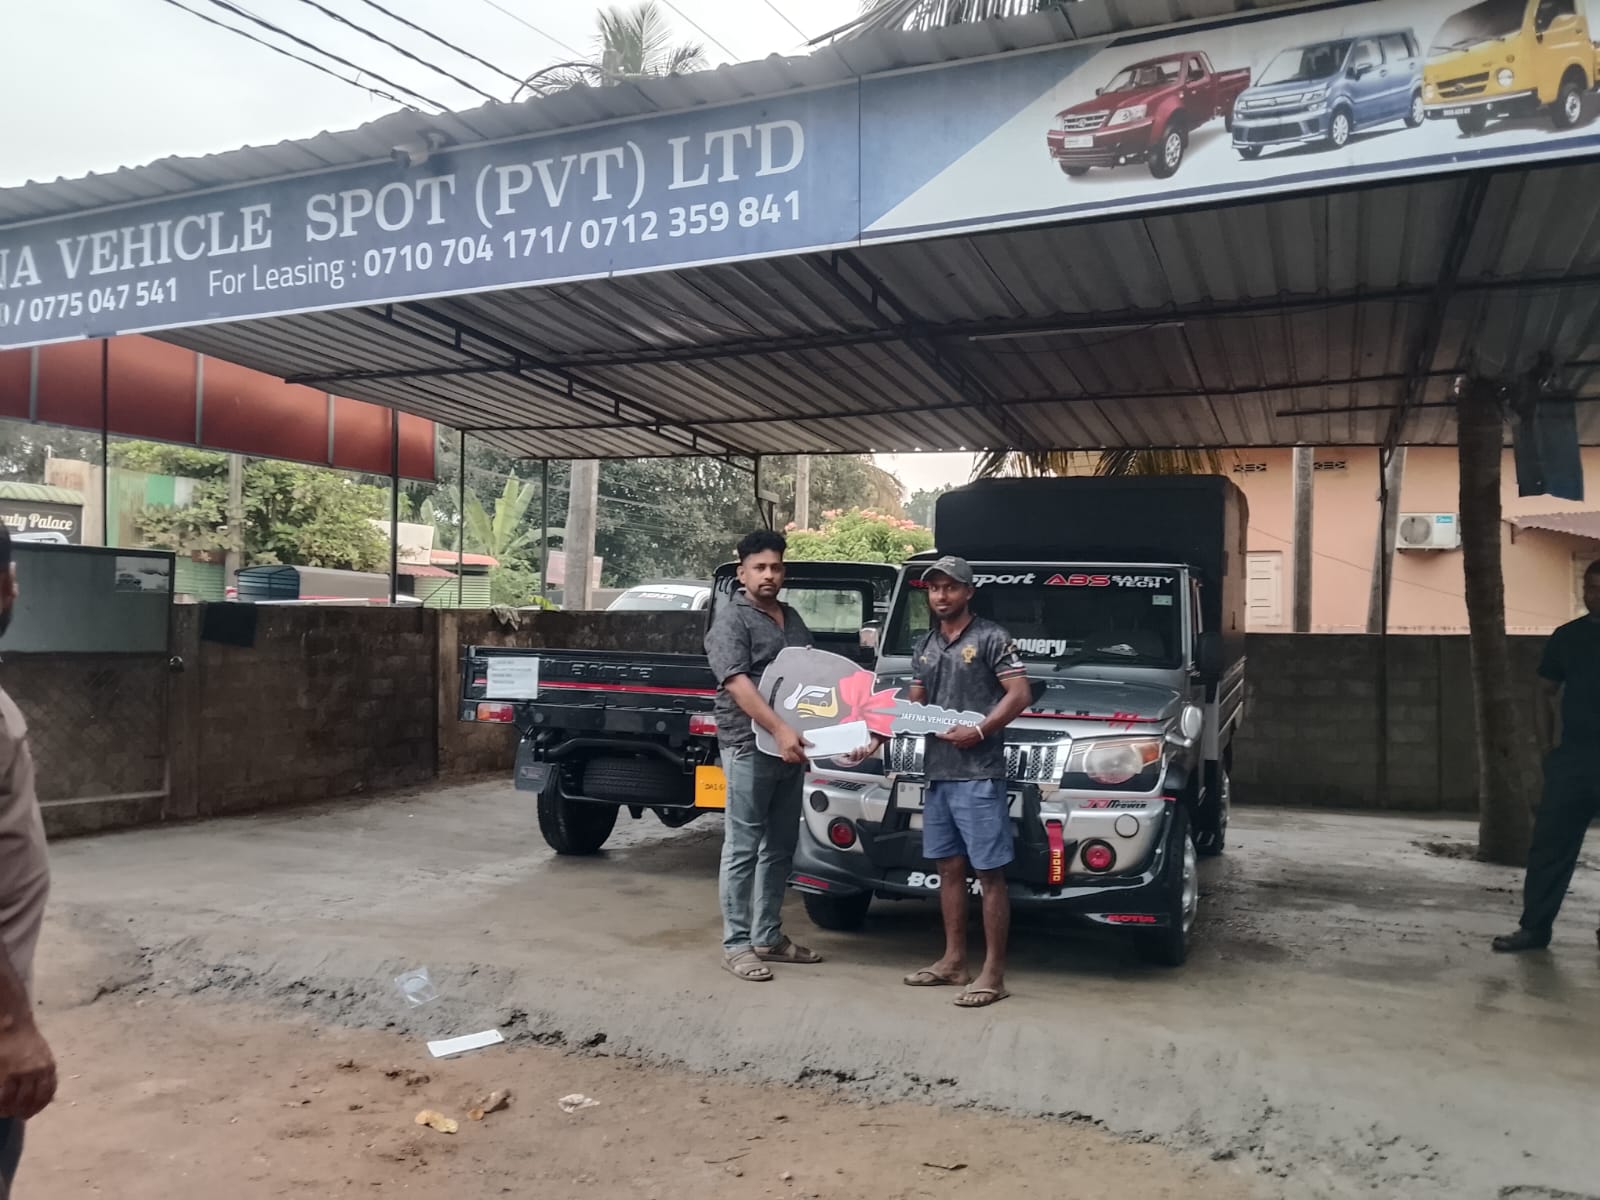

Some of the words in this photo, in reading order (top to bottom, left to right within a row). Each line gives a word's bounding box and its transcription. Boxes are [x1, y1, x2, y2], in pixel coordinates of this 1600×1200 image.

[57, 203, 273, 279] VEHICLE
[306, 174, 456, 242] SPOT
[475, 140, 645, 229] (PVT)
[668, 119, 804, 190] LTD
[30, 291, 83, 322] 0775
[88, 285, 130, 314] 047
[136, 277, 177, 307] 541
[209, 269, 246, 297] For
[253, 256, 344, 292] Leasing
[364, 242, 433, 277] 0710
[441, 234, 493, 267] 704
[580, 211, 658, 248] 0712
[668, 201, 729, 237] 359
[739, 190, 800, 228] 841
[29, 513, 73, 530] Palace
[1044, 574, 1111, 586] ABS
[1111, 575, 1174, 584] SAFETY
[927, 716, 957, 726] VEHICLE
